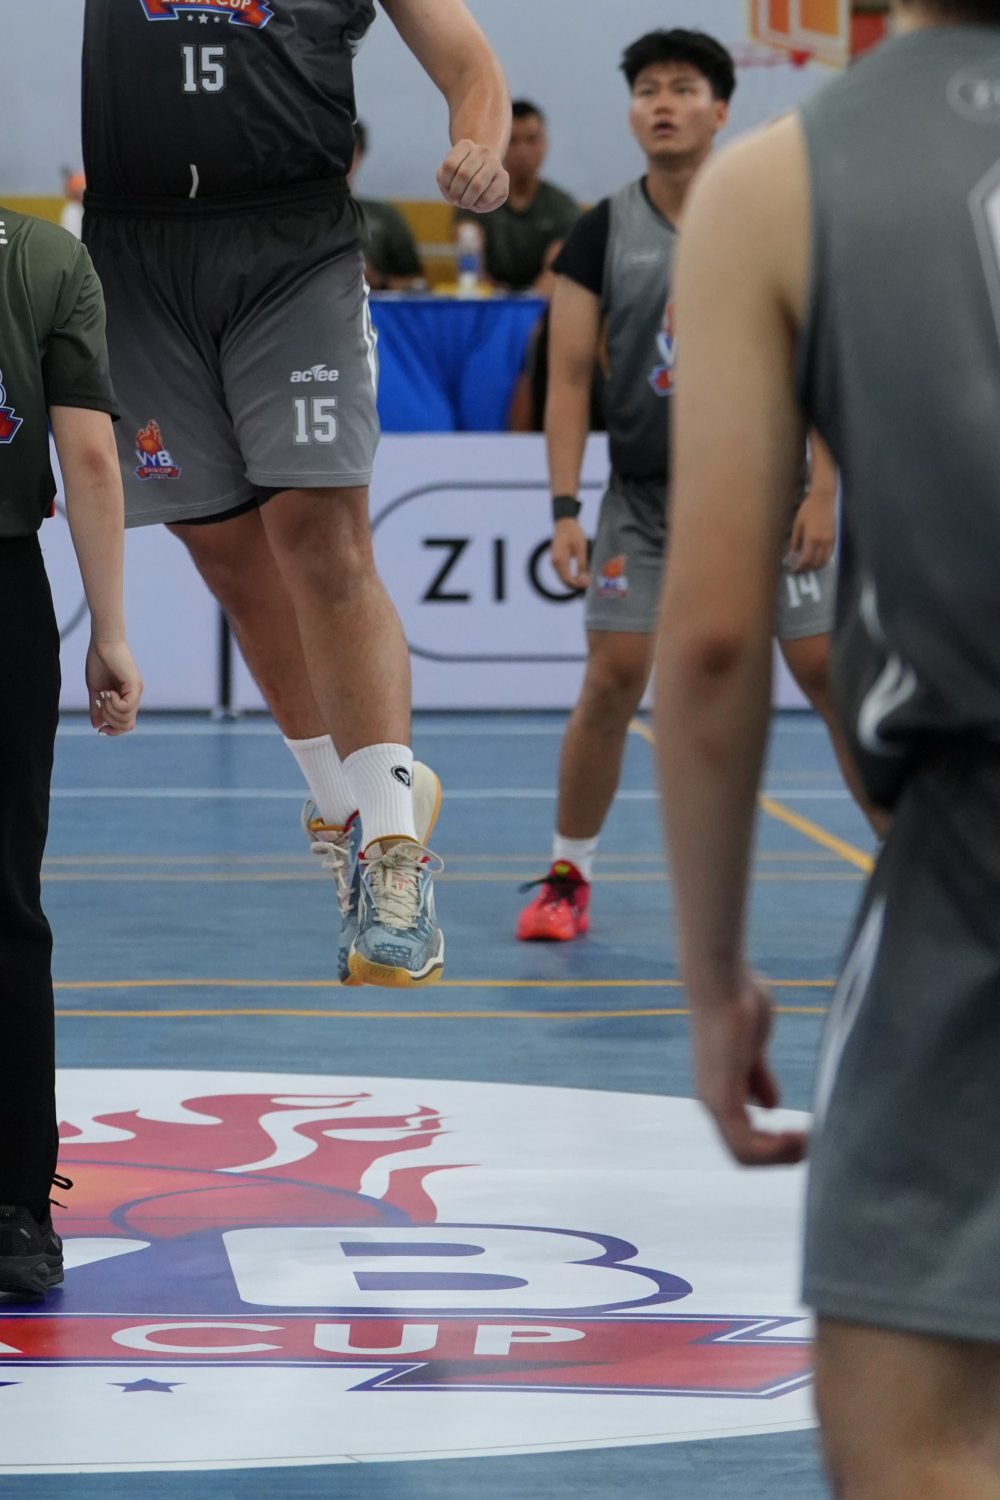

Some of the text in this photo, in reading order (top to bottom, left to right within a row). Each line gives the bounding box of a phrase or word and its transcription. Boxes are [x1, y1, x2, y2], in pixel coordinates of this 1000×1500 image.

[180, 44, 227, 94] 15
[292, 396, 339, 445] 15
[135, 449, 173, 467] VYB
[786, 571, 821, 609] 14
[111, 1322, 587, 1356] CUP
